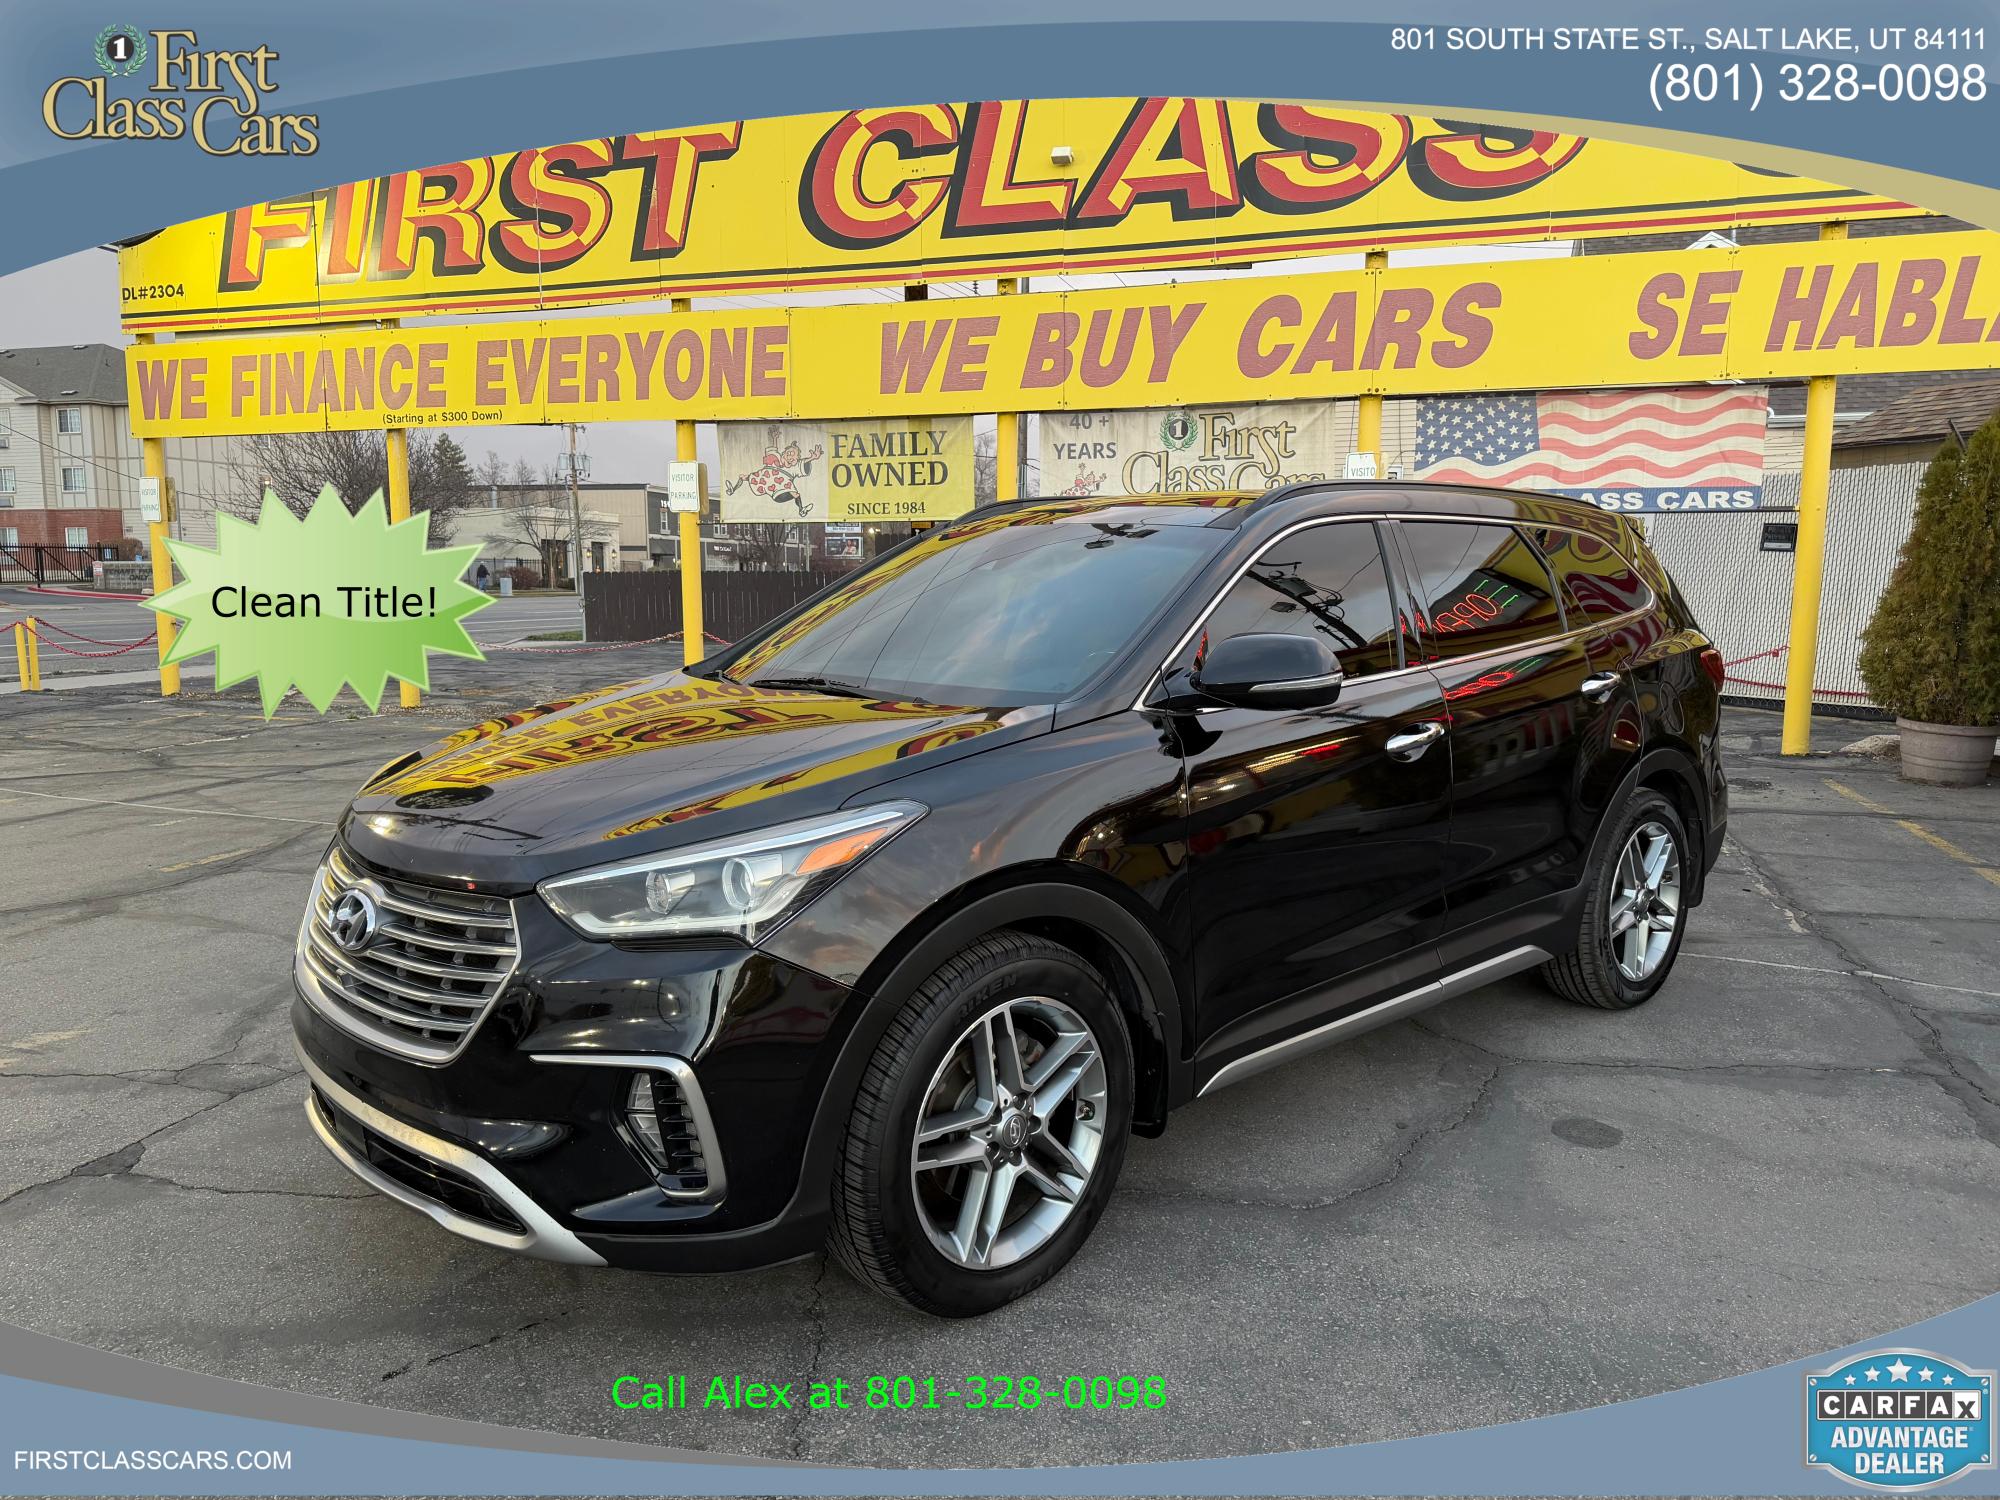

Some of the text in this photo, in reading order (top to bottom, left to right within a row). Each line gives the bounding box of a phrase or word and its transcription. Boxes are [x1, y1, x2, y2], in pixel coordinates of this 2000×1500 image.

[218, 121, 743, 293] FIRST
[121, 283, 185, 301] DL#2304
[1628, 255, 2000, 360] SE HABL
[879, 281, 1502, 394] WE BUY CARS
[136, 325, 789, 420] WE FINANCE EVERYONE
[382, 409, 503, 425] (Starting at $300 Down)
[1068, 413, 1093, 430] 40
[830, 429, 949, 459] FAMILY
[1053, 441, 1118, 461] YEARS
[1198, 411, 1297, 478] First
[671, 473, 695, 482] VISITOR
[831, 459, 950, 489] OWNED
[1121, 450, 1226, 496] Class
[1350, 466, 1377, 478] VISITO
[670, 491, 698, 500] PARKING
[1656, 489, 1755, 510] CARS
[847, 501, 926, 515] SINCE 1984
